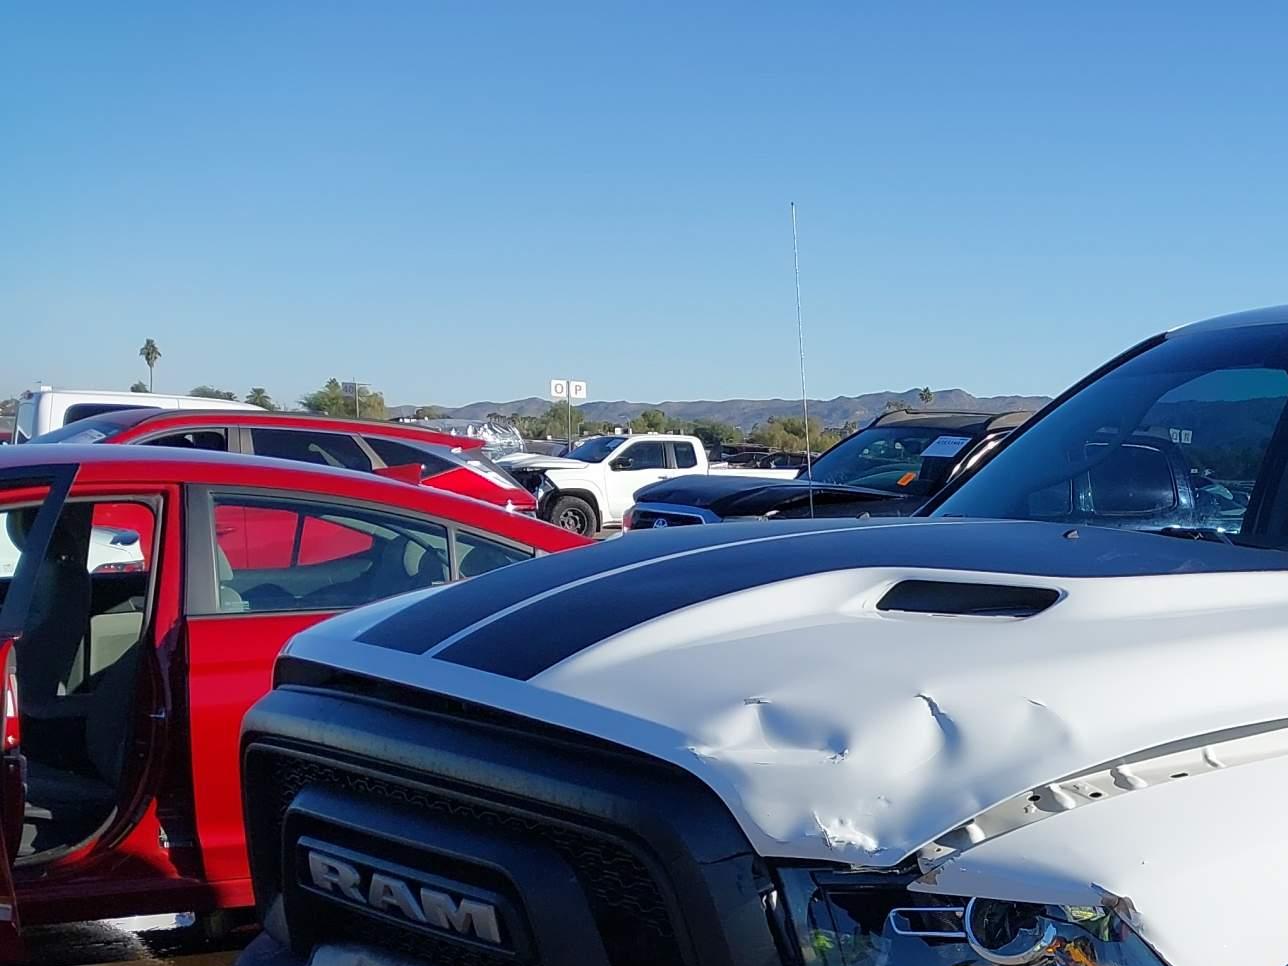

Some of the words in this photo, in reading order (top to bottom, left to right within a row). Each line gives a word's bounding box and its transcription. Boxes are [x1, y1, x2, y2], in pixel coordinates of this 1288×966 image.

[554, 383, 564, 394] O
[574, 384, 582, 396] P
[308, 851, 501, 943] RAM
